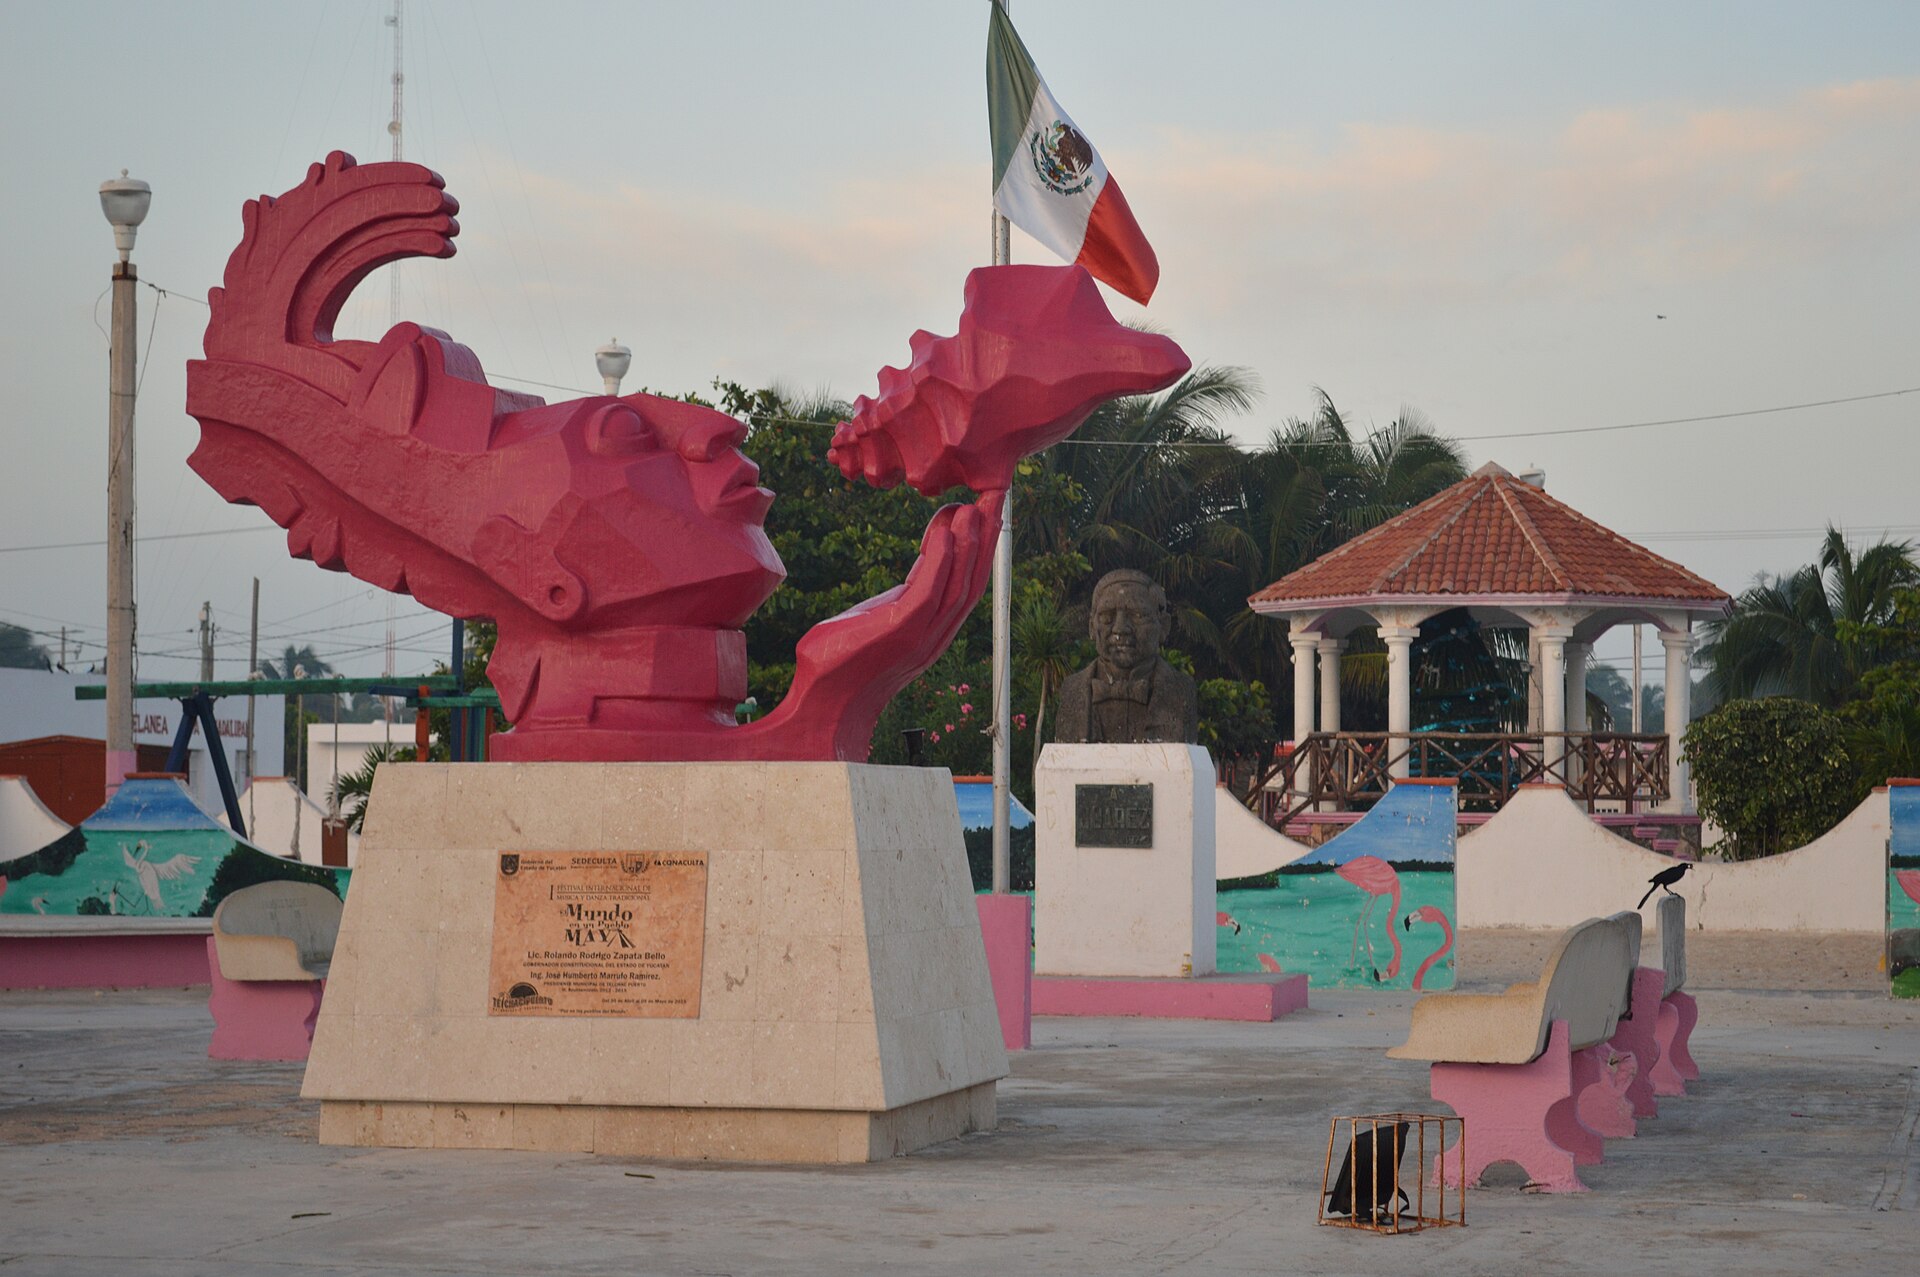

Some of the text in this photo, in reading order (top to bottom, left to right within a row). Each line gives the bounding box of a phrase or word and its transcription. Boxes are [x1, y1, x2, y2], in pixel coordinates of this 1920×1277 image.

[567, 904, 633, 921] Mundo
[597, 920, 630, 929] Pueblo
[564, 928, 636, 948] MAYA
[527, 951, 666, 961] Lic. Rolando Rodrigo Zapata Bello
[530, 971, 543, 980] Ing.
[562, 971, 598, 980] Humberto
[599, 972, 628, 980] Marrufo
